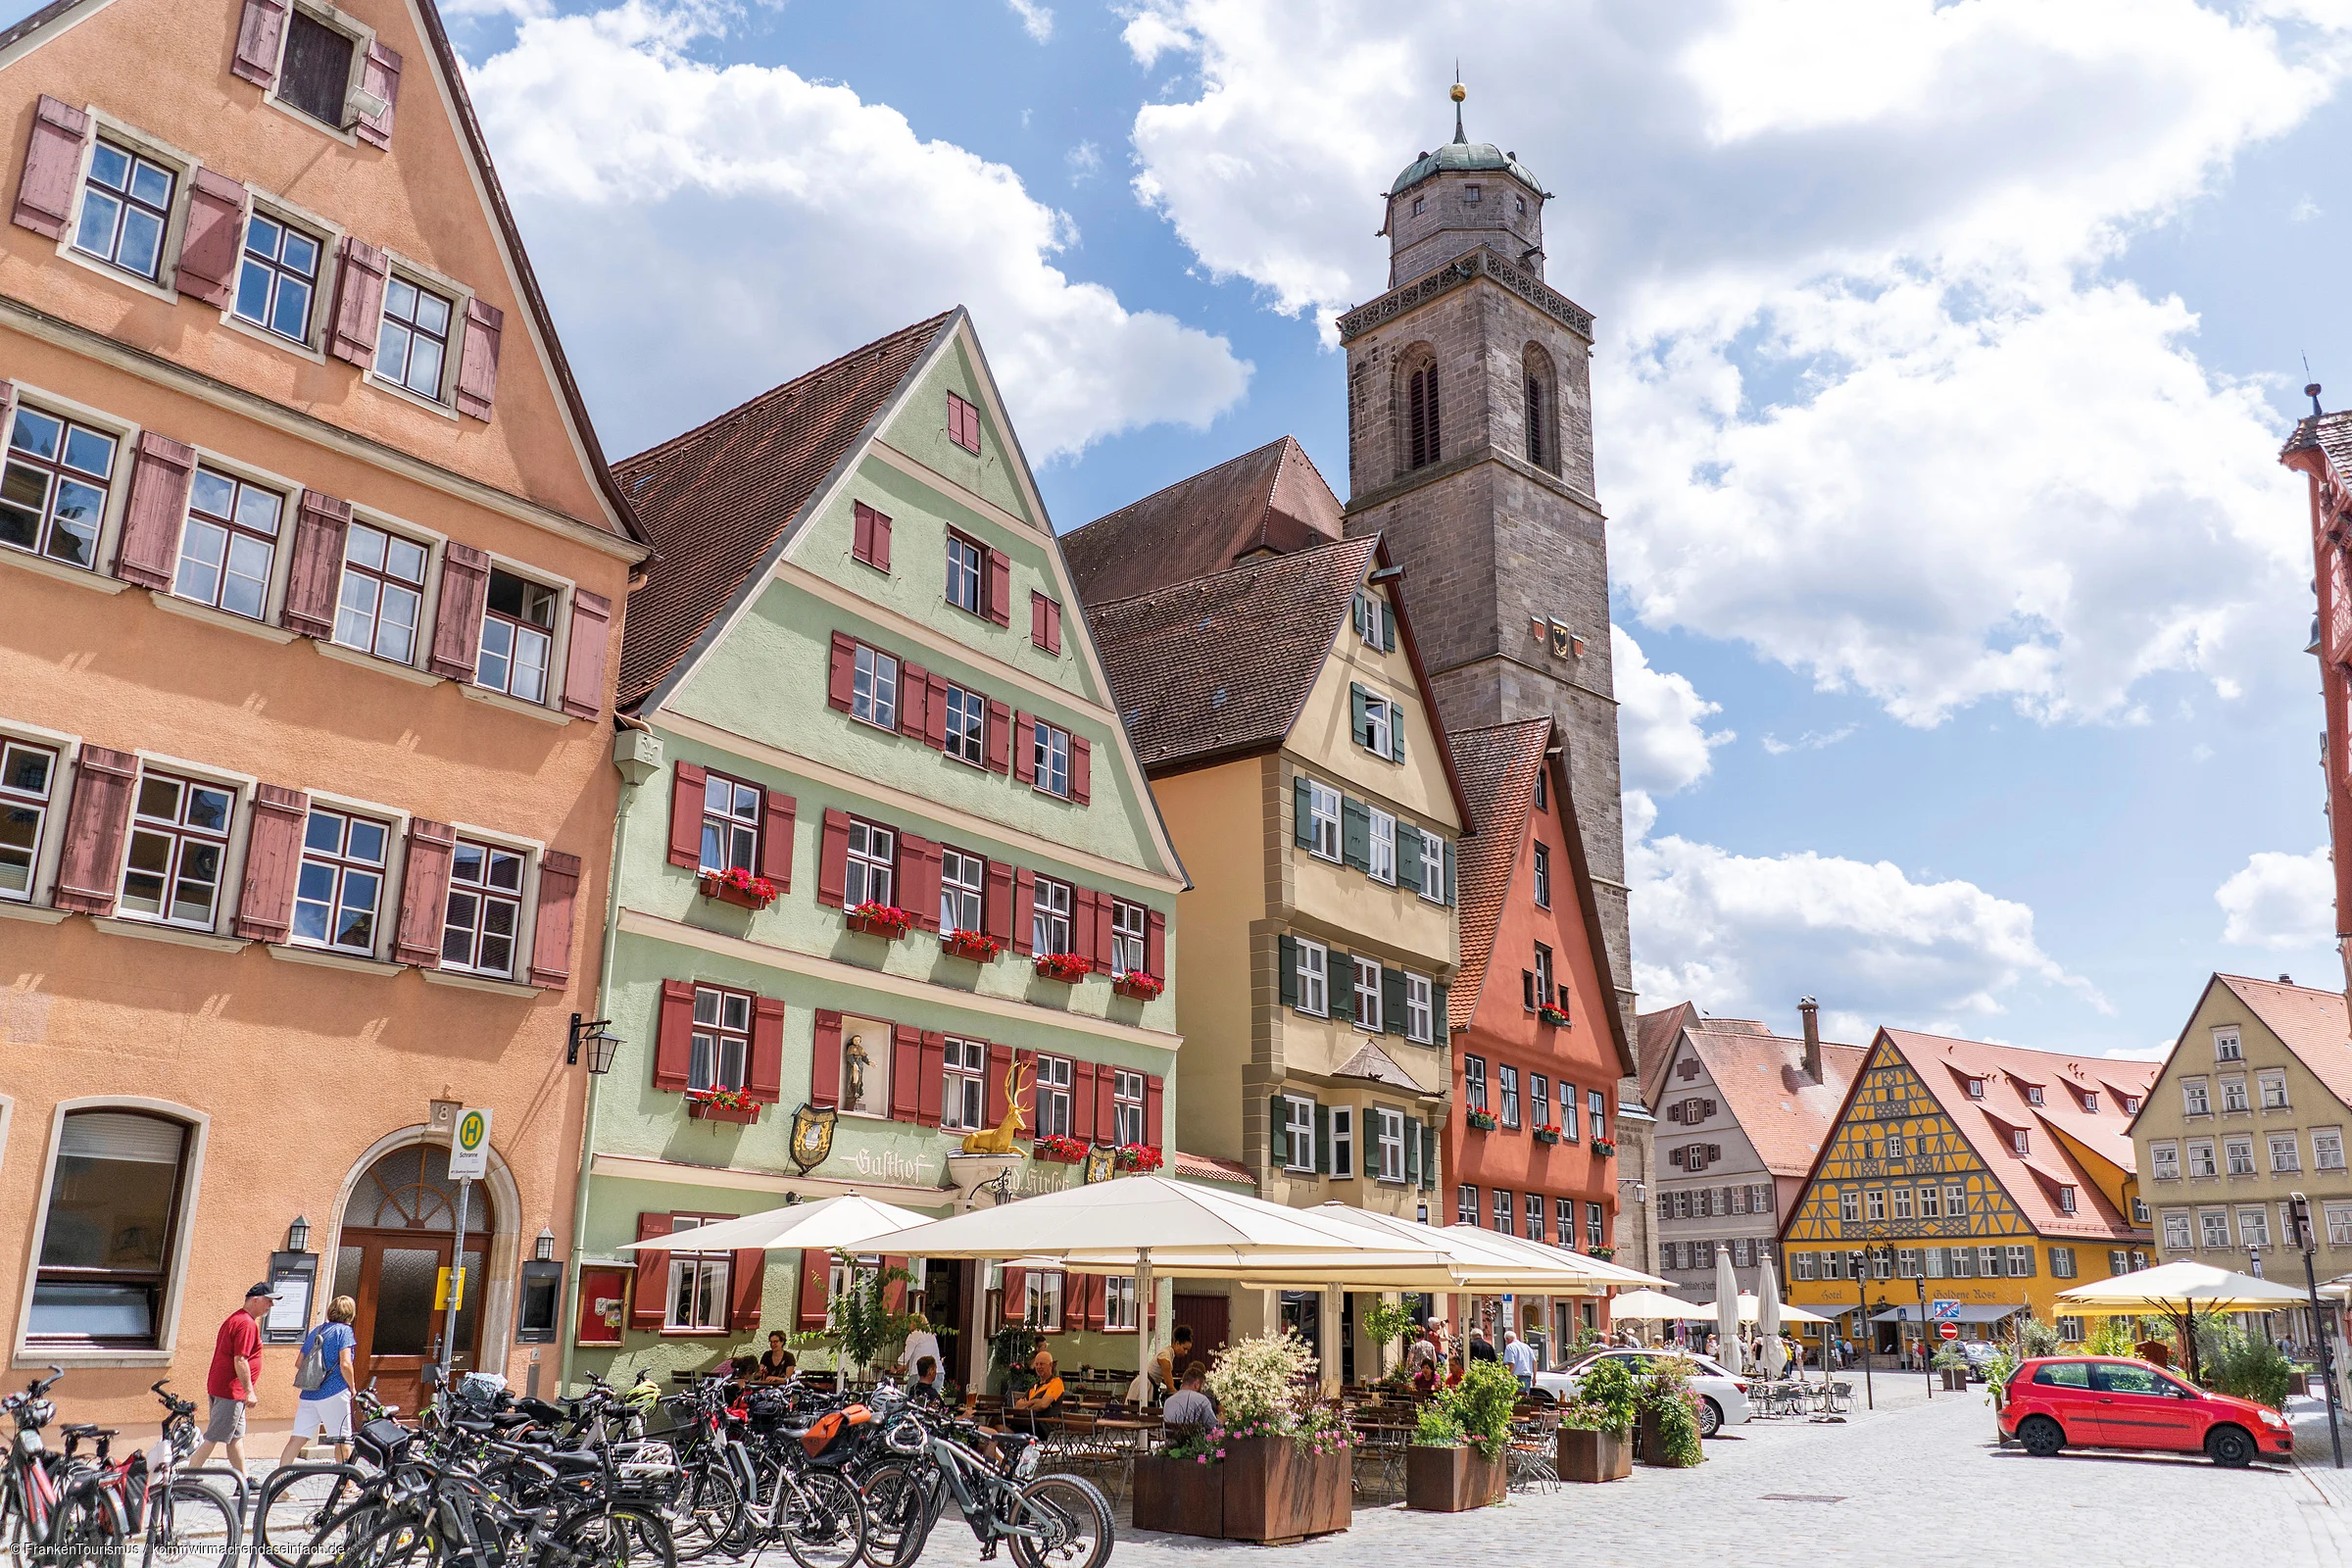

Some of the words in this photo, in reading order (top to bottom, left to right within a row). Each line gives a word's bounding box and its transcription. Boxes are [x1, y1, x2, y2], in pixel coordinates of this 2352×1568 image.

[438, 1105, 449, 1120] 8
[465, 1120, 478, 1142] H
[1821, 1289, 1842, 1300] Hotel
[1933, 1289, 1970, 1299] Goldene
[1972, 1289, 1996, 1299] Rose
